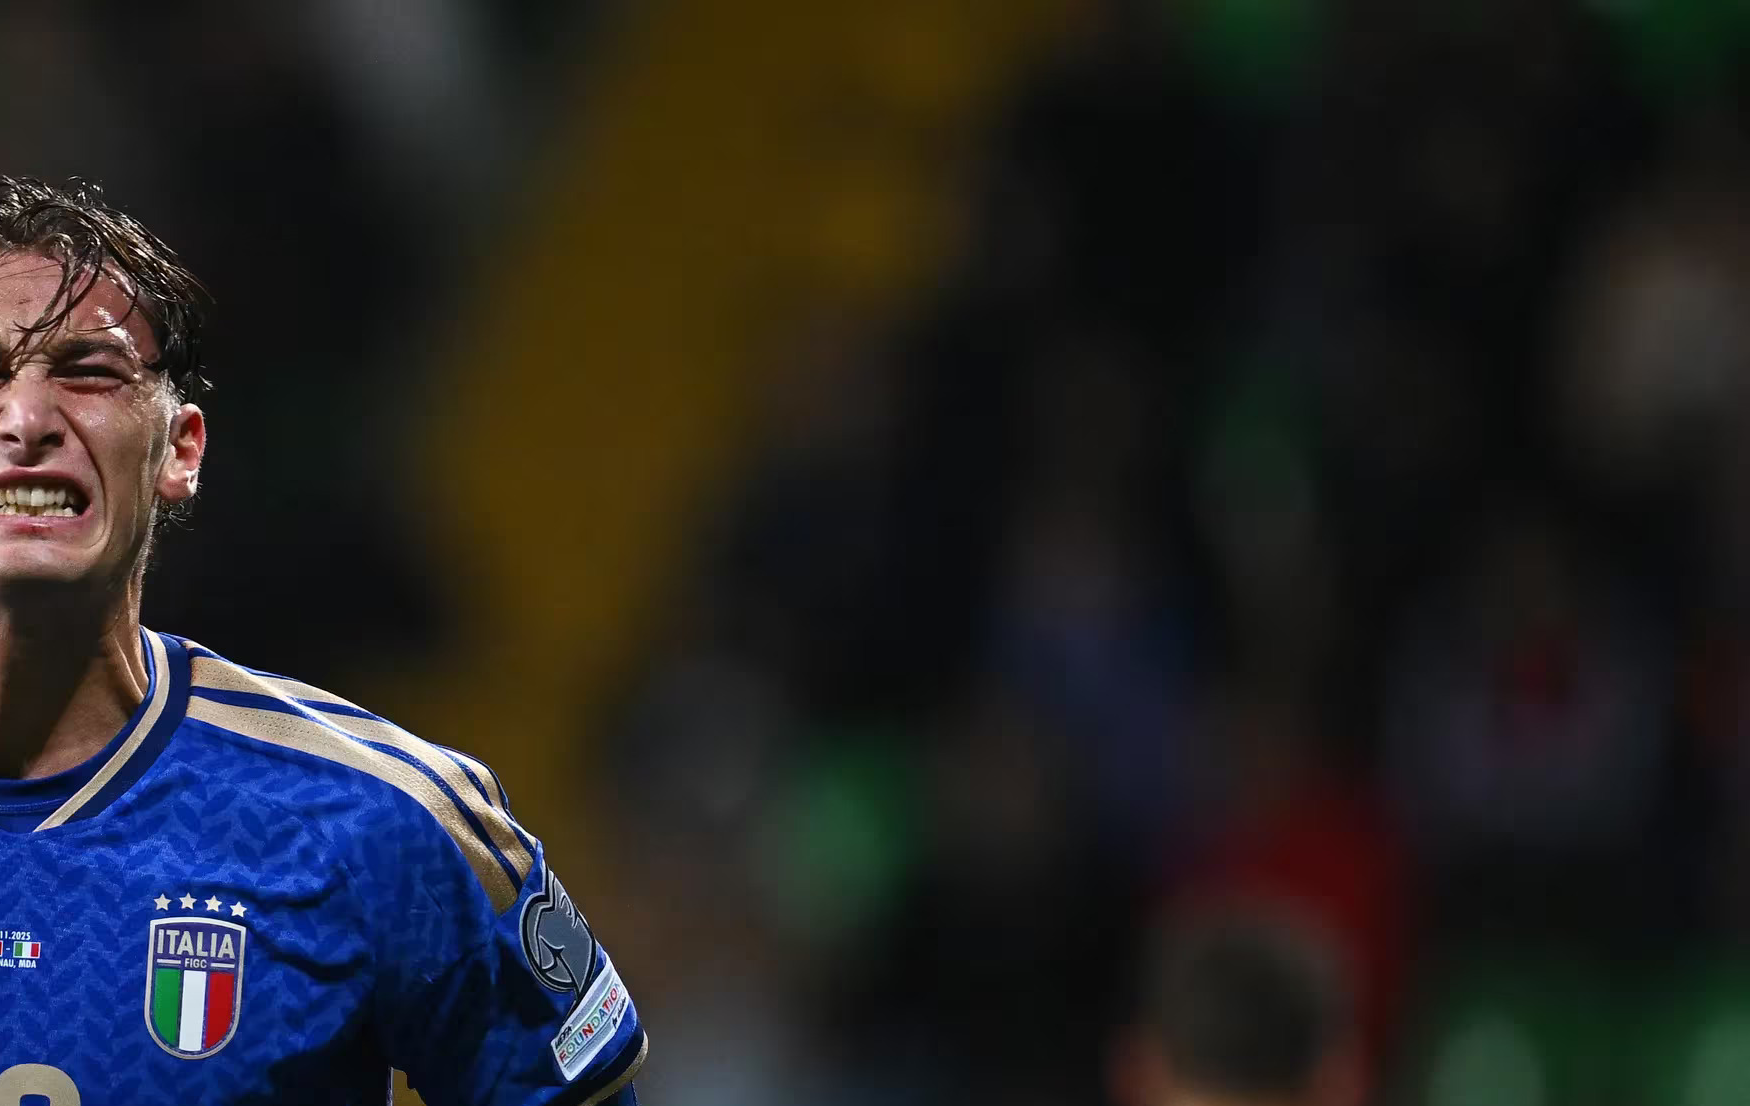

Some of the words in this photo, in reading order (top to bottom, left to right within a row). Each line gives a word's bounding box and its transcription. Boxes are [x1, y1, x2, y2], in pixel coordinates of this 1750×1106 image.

[157, 928, 236, 959] ITALIA
[18, 959, 37, 969] MDA
[184, 958, 208, 969] FIGC
